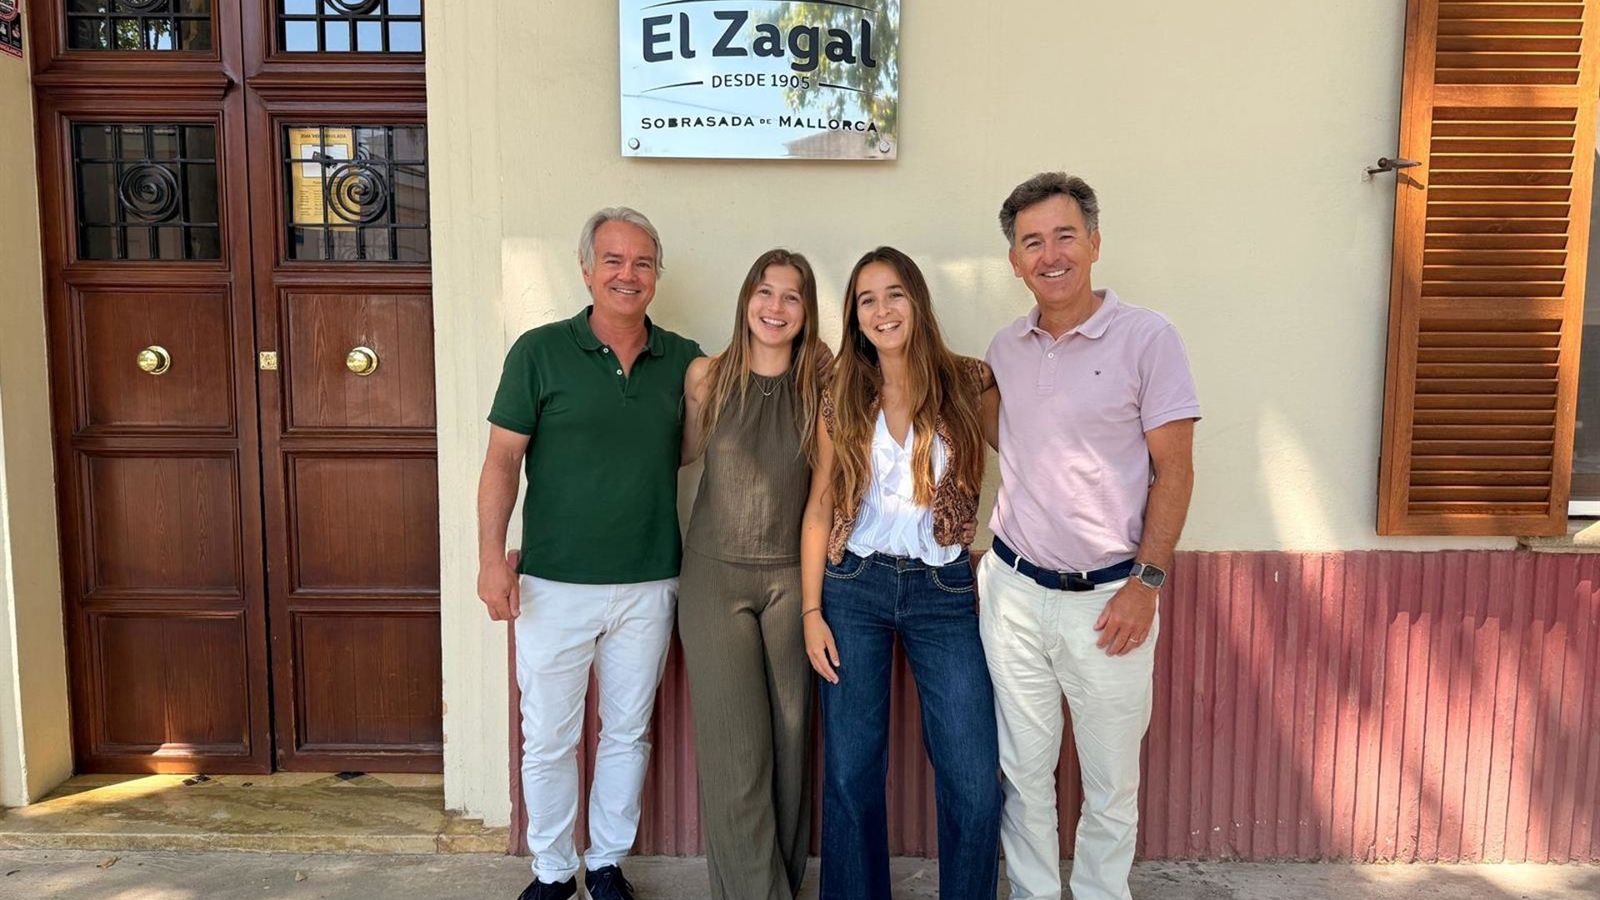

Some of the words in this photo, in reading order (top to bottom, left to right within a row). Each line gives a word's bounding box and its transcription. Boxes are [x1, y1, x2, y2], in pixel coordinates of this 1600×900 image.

[643, 12, 696, 62] El
[712, 10, 876, 72] Zagal
[712, 74, 765, 88] DESDE
[771, 74, 810, 89] 1905
[641, 116, 754, 129] SOBRASADA
[779, 116, 878, 132] MALLORCA
